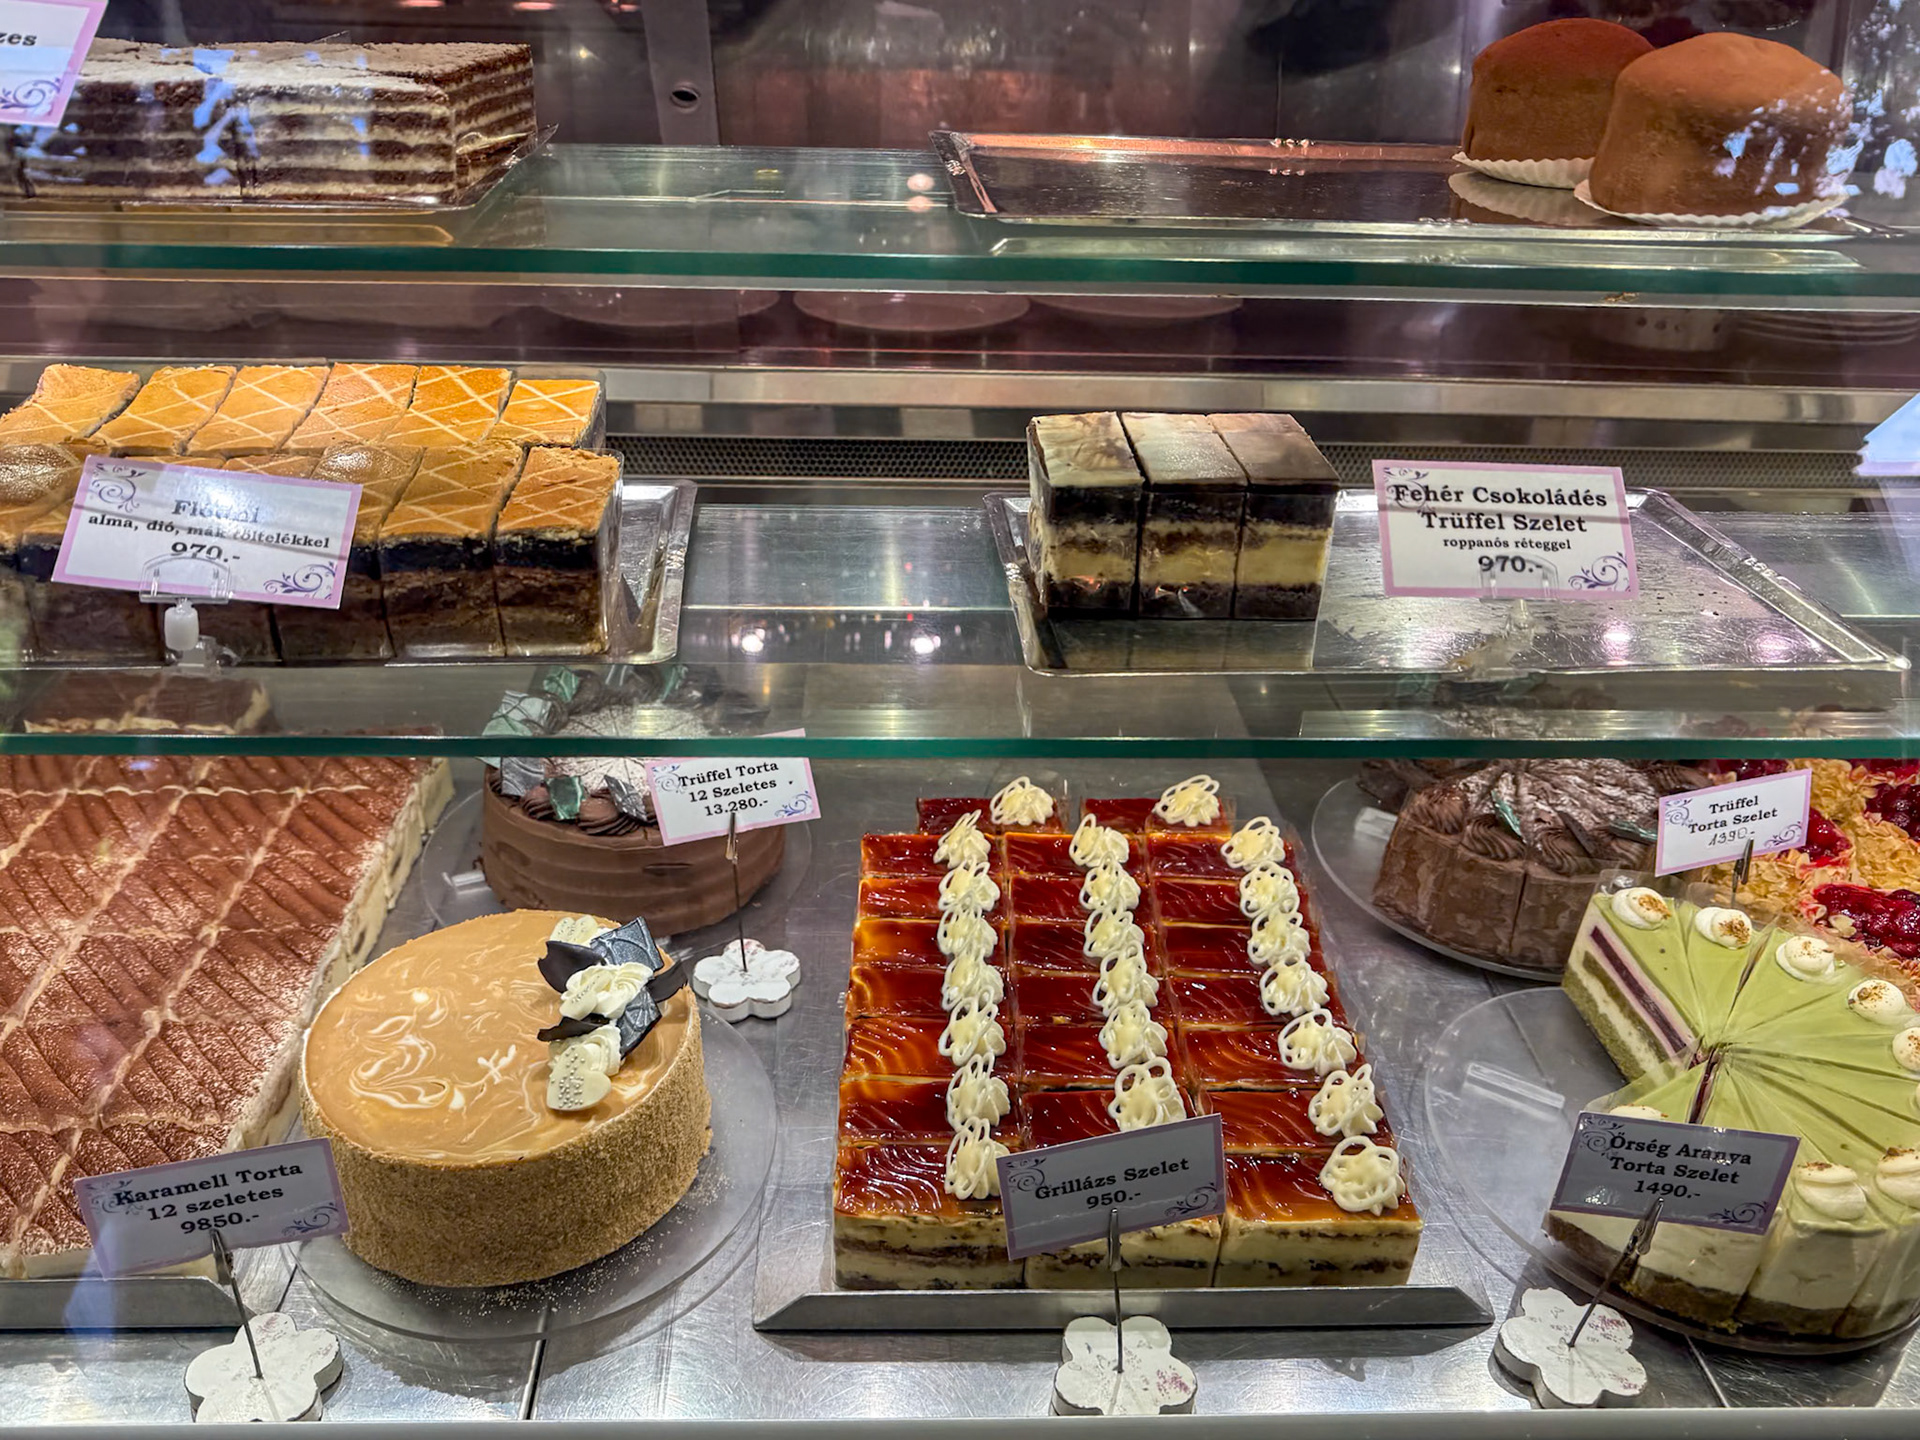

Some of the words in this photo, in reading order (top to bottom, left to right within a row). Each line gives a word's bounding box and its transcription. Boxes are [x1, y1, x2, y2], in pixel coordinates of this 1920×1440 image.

[1394, 484, 1464, 503] Fehér
[1472, 486, 1607, 507] Csokoládés
[88, 514, 139, 531] alma,
[147, 520, 180, 536] dió,
[187, 524, 227, 539] mák
[232, 529, 330, 548] töltelékkel
[1421, 511, 1505, 530] Trüffel
[1514, 514, 1587, 532] Szelet
[171, 541, 240, 562] 970.-
[1443, 537, 1509, 551] roppanós
[1514, 537, 1572, 552] réteggel
[1478, 555, 1543, 573] 970.-
[678, 768, 732, 788] Trüffel
[736, 762, 779, 777] Torta
[689, 790, 708, 803] 12
[713, 778, 777, 798] Szeletes
[705, 797, 769, 816] 13.280.-
[1709, 795, 1758, 814] Trüffel
[1688, 820, 1727, 834] Torta
[1733, 807, 1778, 824] Szelet
[1675, 1144, 1751, 1166] Aranya
[1035, 1173, 1116, 1200] Grillázs
[1124, 1158, 1190, 1182] Szelet
[1610, 1156, 1665, 1175] Torta
[1673, 1164, 1740, 1184] Szelet
[114, 1173, 229, 1206] Karamell
[236, 1162, 303, 1184] Torta
[1634, 1180, 1701, 1198] 1490.-
[147, 1204, 178, 1221] 12
[186, 1187, 284, 1214] szeletes
[1086, 1190, 1141, 1209] 950.-
[180, 1211, 259, 1235] 9850.-
